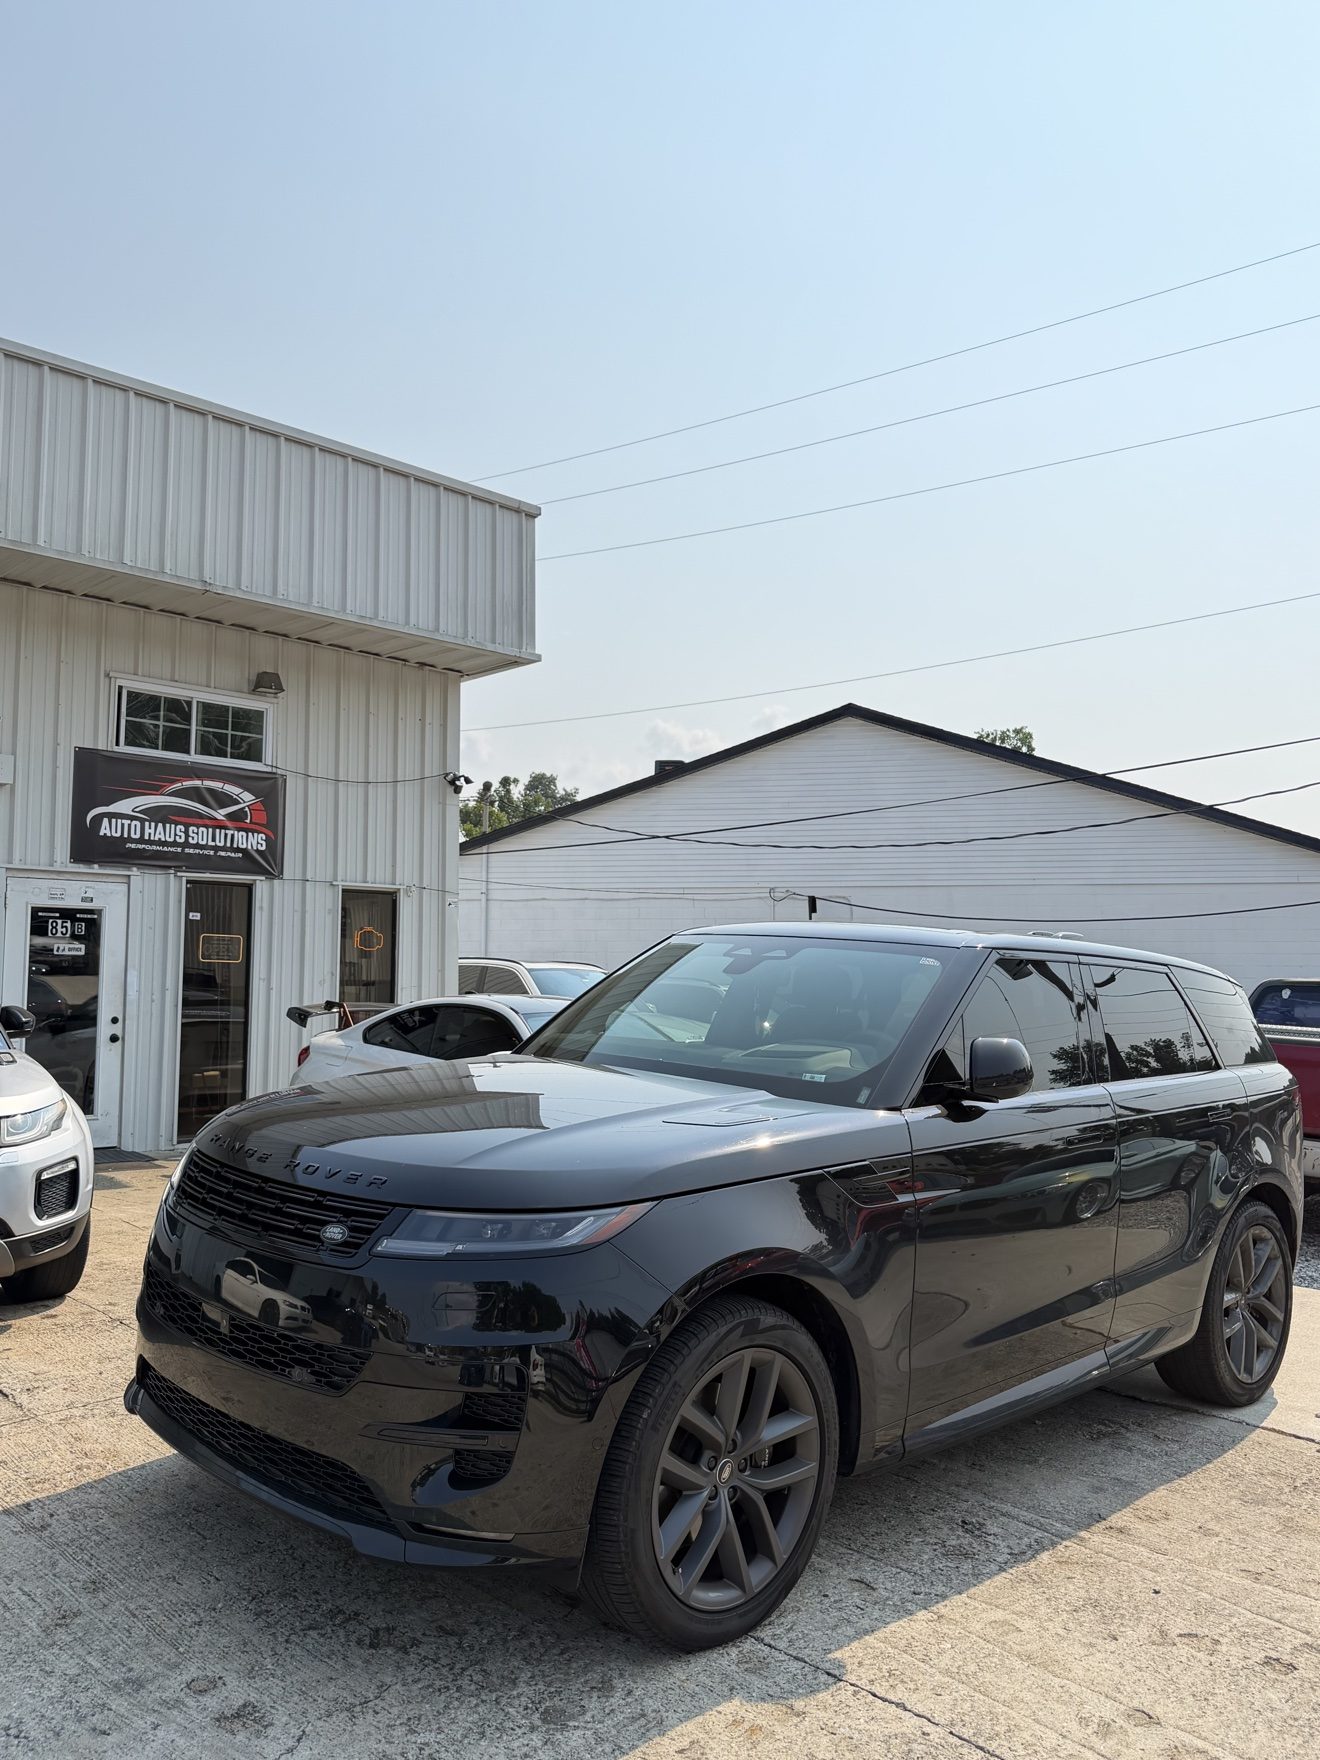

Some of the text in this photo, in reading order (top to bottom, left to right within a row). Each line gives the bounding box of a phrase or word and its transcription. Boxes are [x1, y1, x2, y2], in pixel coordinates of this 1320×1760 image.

[99, 817, 267, 850] AUTO HAUS SOLUTIONS
[125, 843, 182, 853] PERFORMANCE
[184, 848, 214, 856] SERVICE
[50, 920, 84, 936] 85 B
[209, 1133, 388, 1189] RANGE ROVER
